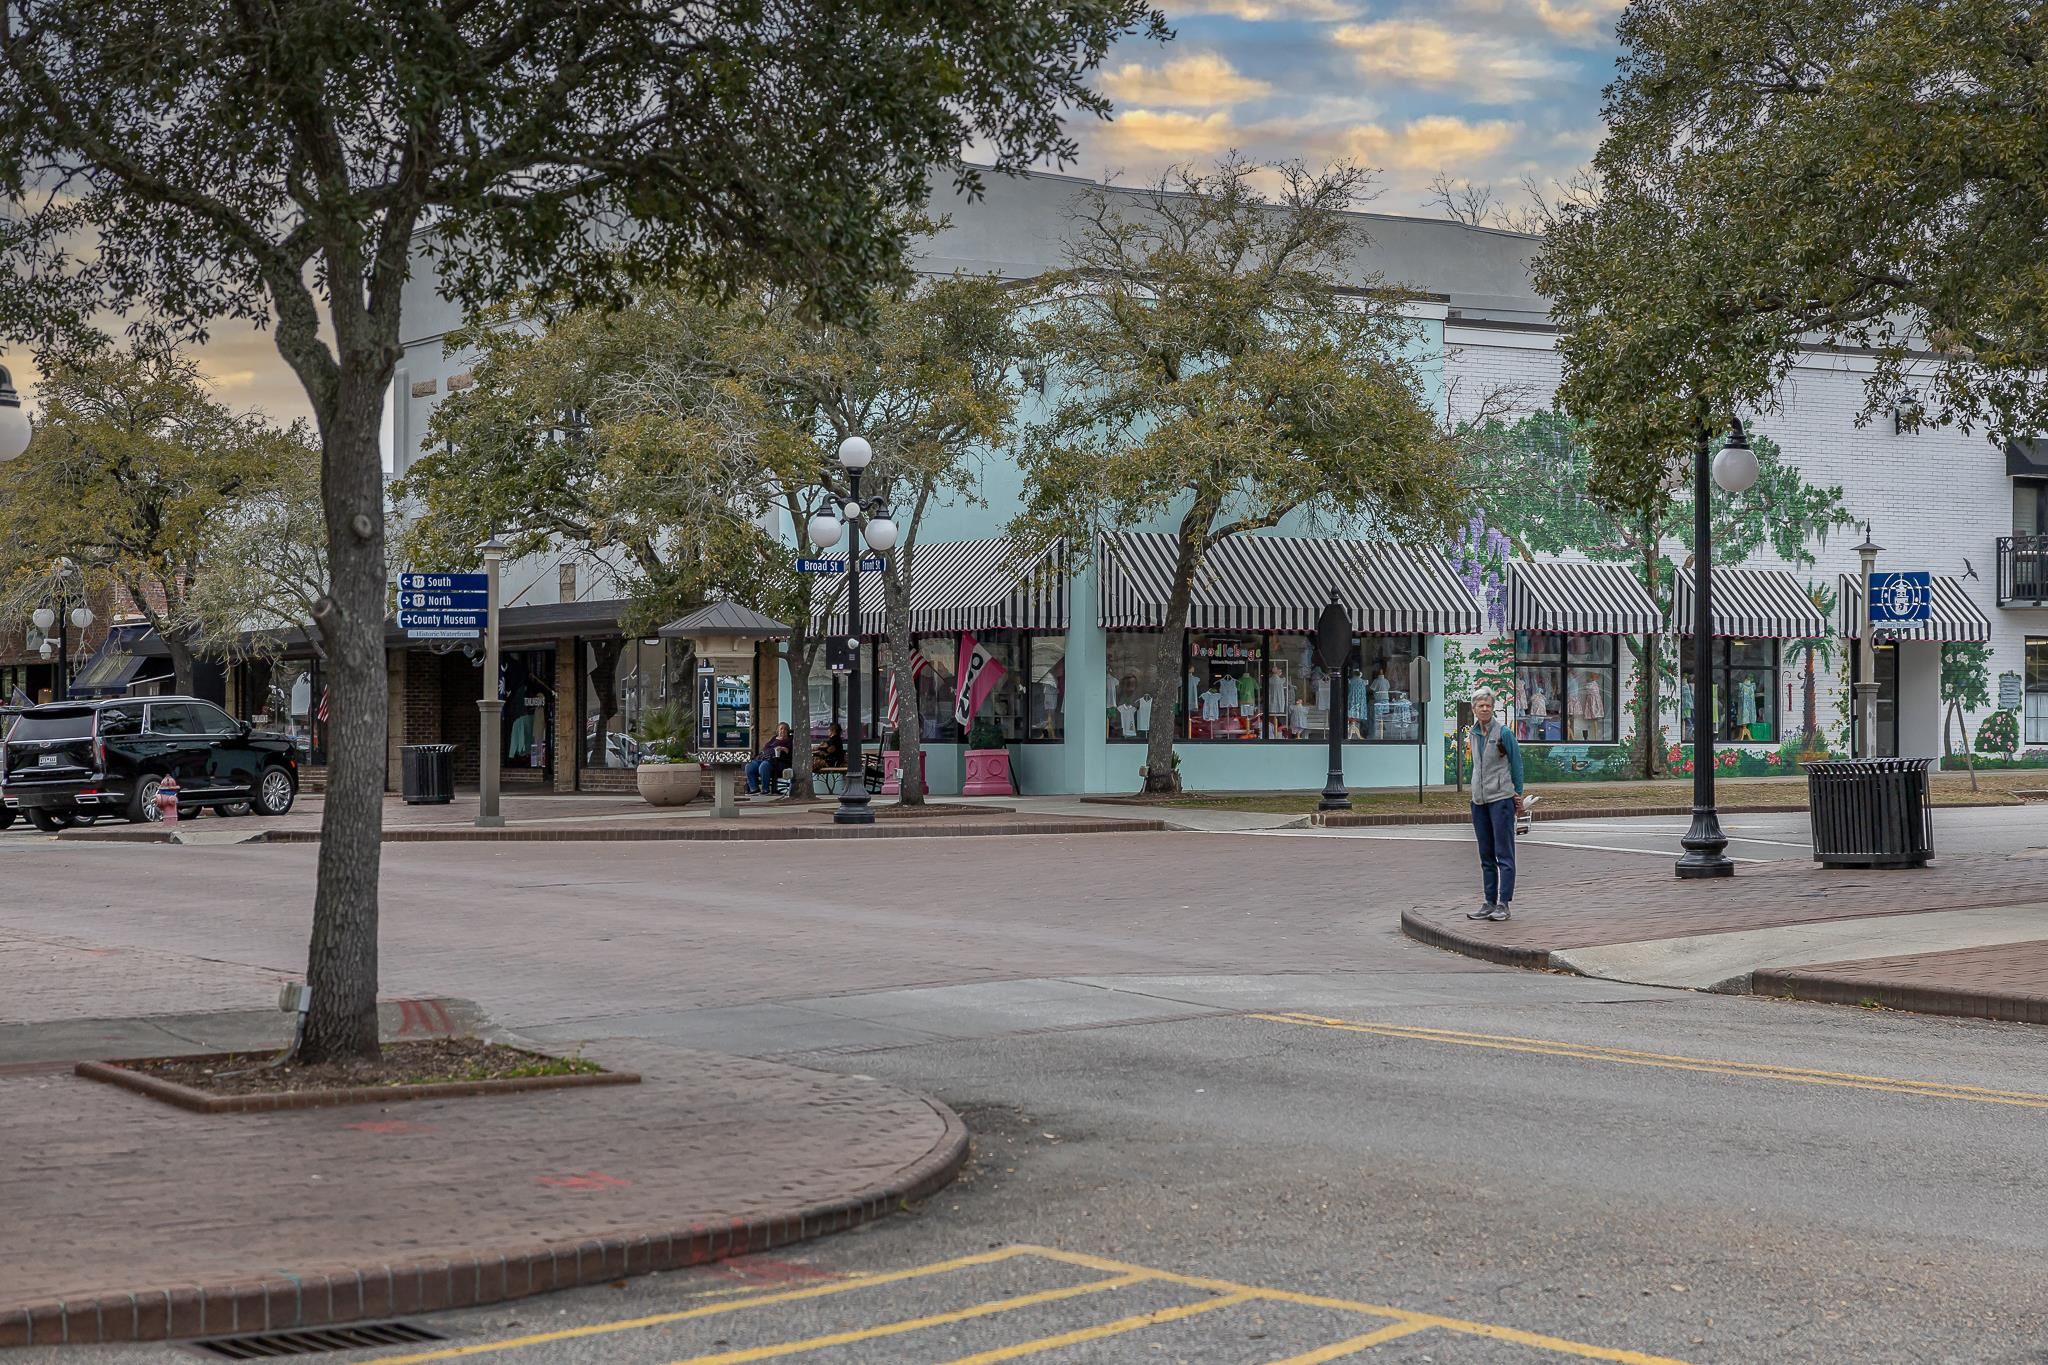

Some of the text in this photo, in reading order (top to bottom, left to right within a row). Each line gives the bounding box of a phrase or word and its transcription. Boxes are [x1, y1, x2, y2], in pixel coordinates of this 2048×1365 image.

[804, 560, 838, 571] Broad St
[862, 560, 881, 570] Front St
[414, 577, 451, 587] 17 South
[415, 595, 452, 606] 17 North
[412, 615, 476, 627] County Museum
[1192, 642, 1261, 661] Doodlebugs
